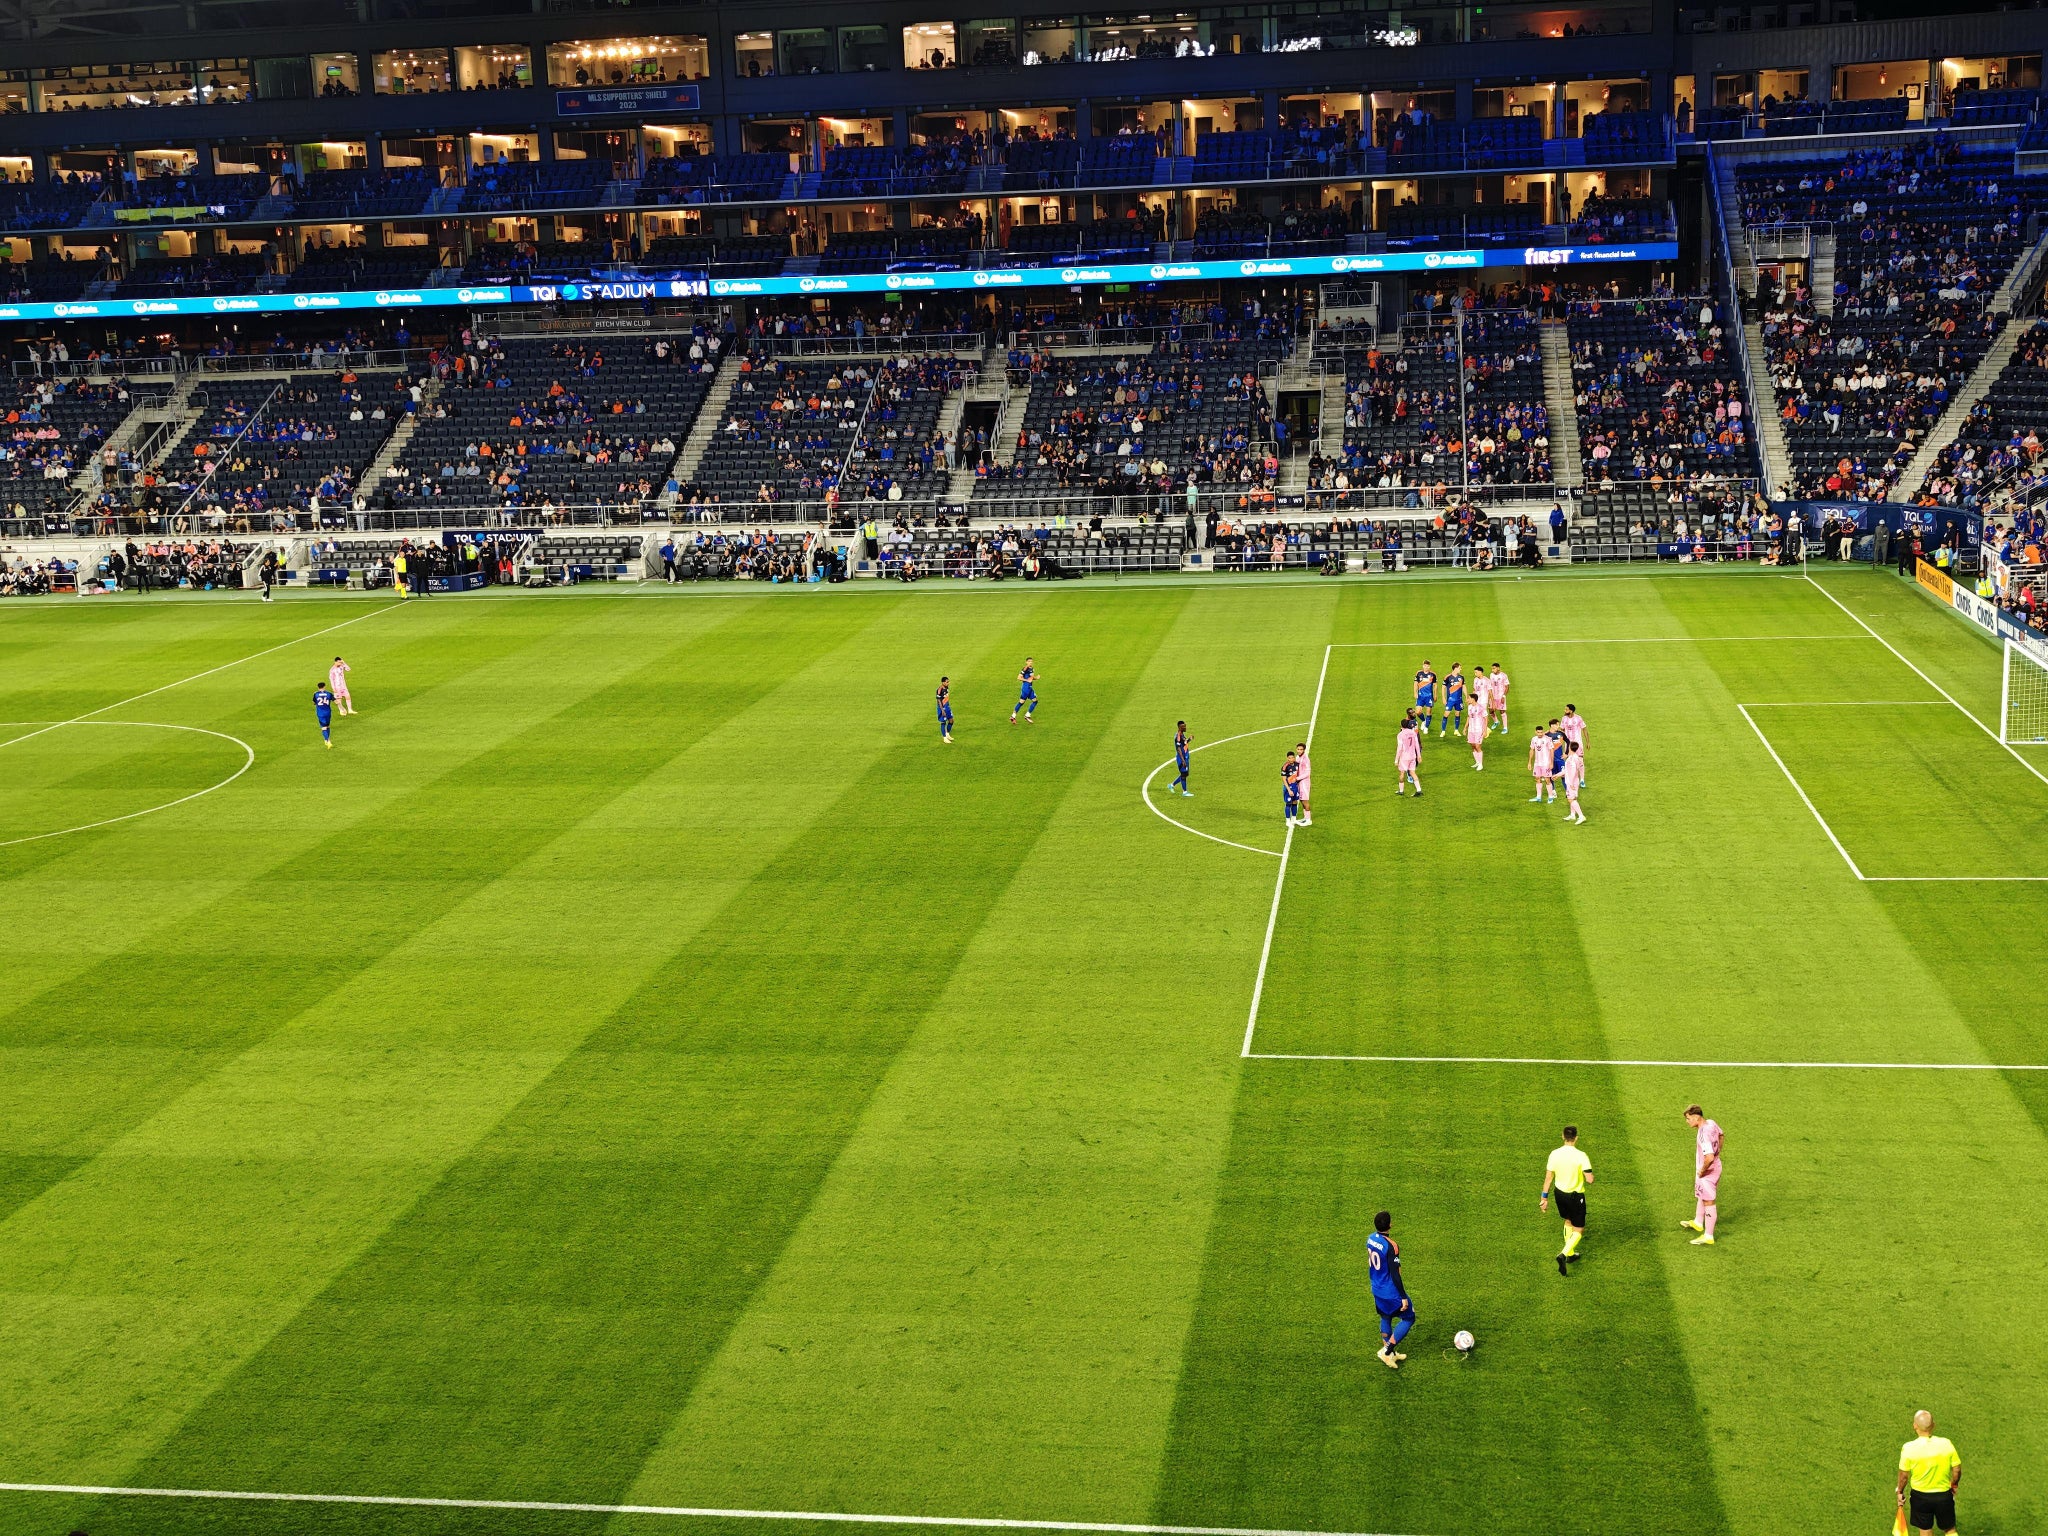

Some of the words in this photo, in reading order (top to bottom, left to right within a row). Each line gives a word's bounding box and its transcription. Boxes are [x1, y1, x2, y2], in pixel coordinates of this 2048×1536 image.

[588, 94, 601, 102] MLS
[602, 92, 644, 101] SUPPORTERS'
[645, 91, 667, 99] SHIELD
[619, 101, 637, 109] 2023
[1594, 251, 1619, 259] financial
[1621, 250, 1636, 258] bank
[582, 282, 656, 299] STADIUM
[1823, 508, 1847, 519] TQL
[1903, 510, 1923, 523] TQL
[453, 534, 476, 543] TQL
[316, 697, 330, 706] 24
